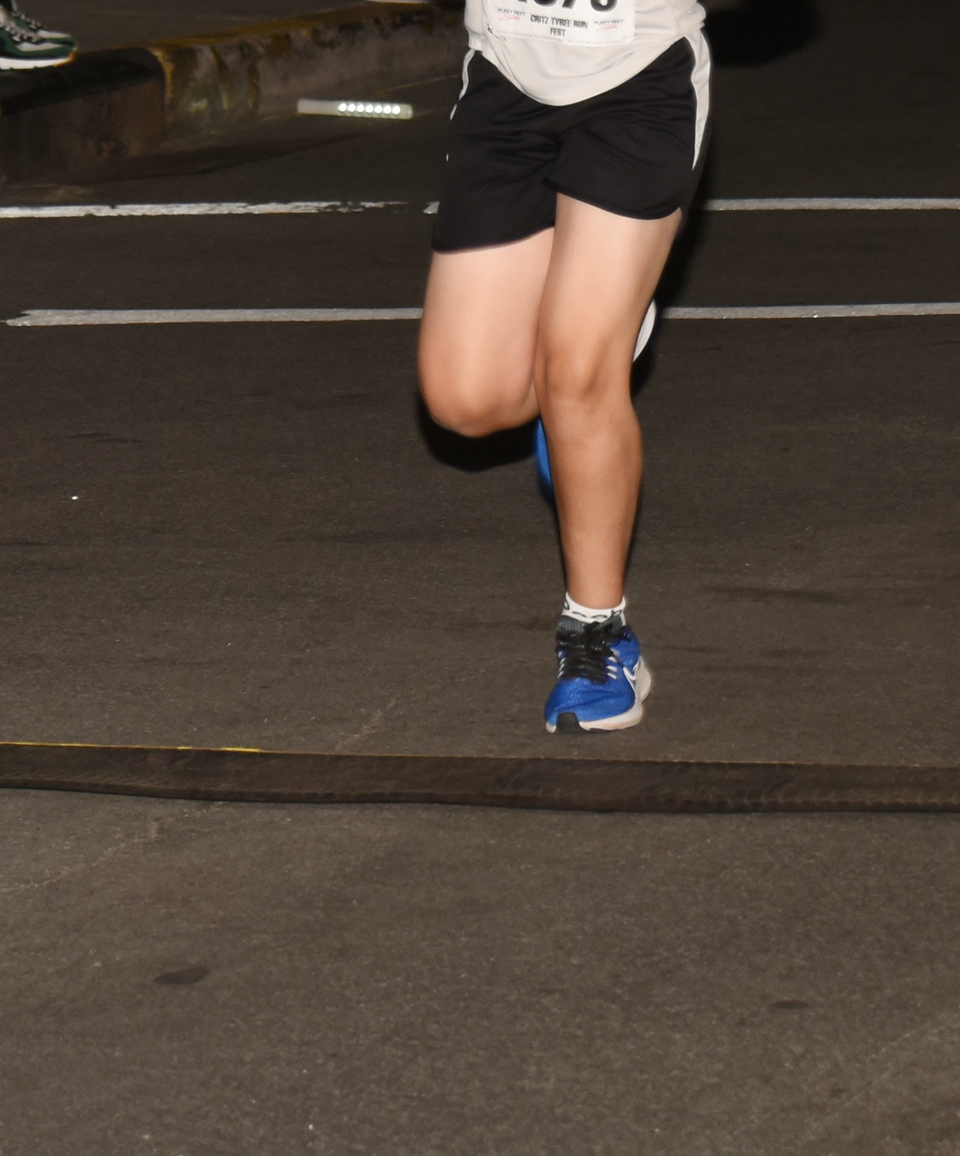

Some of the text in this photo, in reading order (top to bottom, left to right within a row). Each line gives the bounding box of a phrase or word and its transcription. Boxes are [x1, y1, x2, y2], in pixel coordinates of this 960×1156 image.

[551, 17, 572, 28] TYBEE
[573, 20, 588, 30] RUN
[550, 27, 567, 38] FEST
